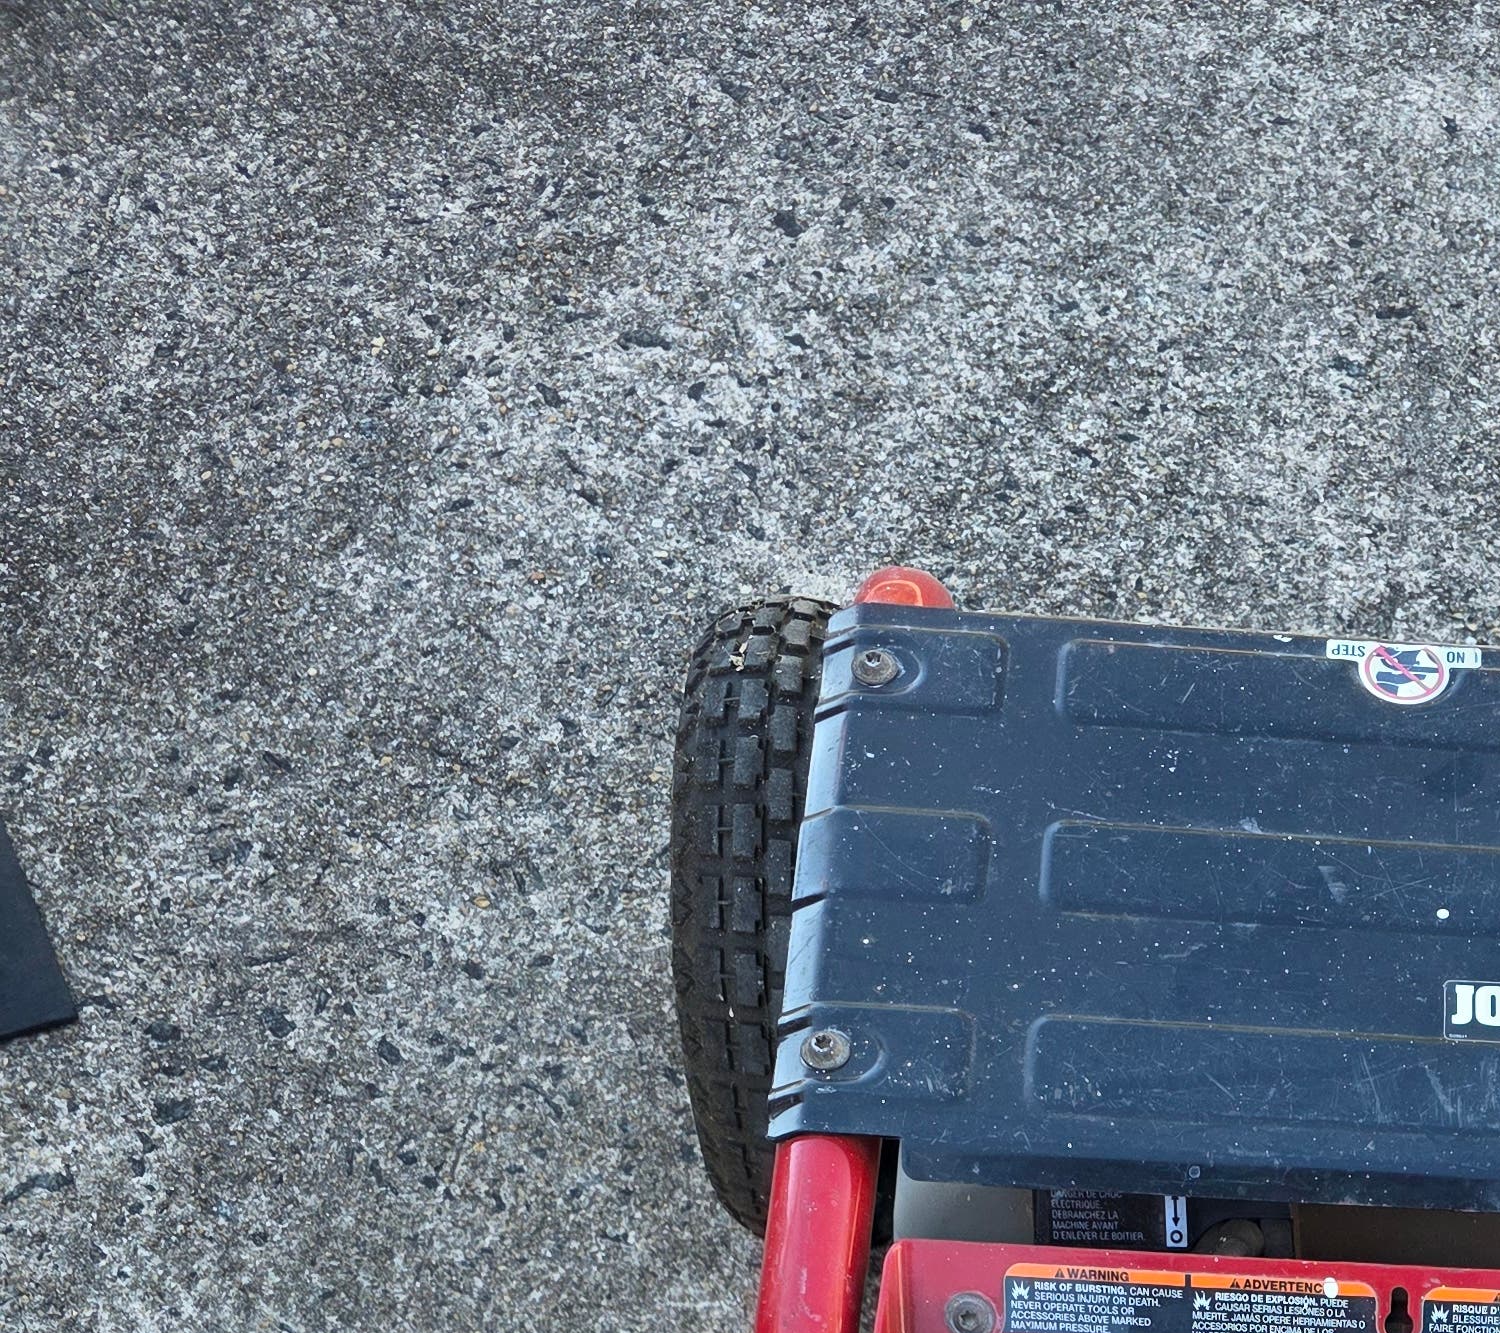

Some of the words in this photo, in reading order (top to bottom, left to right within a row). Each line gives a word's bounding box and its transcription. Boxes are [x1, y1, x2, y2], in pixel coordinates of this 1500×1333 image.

[1332, 644, 1365, 657] STEP
[1447, 652, 1464, 663] NO
[1108, 1211, 1118, 1219] LA
[1052, 1221, 1090, 1229] MACHINE
[1092, 1222, 1118, 1230] AVANT
[1067, 1268, 1129, 1281] WARNING
[1034, 1282, 1056, 1291] RISK
[1059, 1283, 1072, 1292] OF
[1076, 1284, 1127, 1295] BURSTING.
[1130, 1287, 1149, 1296] CAN
[1152, 1289, 1183, 1298] CAUSE
[1244, 1278, 1330, 1293] ADVERTENC
[1034, 1292, 1074, 1302] SERIOUS
[1077, 1294, 1110, 1304] INJURY
[1112, 1296, 1126, 1305] OR
[1215, 1292, 1249, 1302] RIESGO
[1251, 1294, 1263, 1303] DE
[1320, 1298, 1348, 1308] PUEDE
[1011, 1301, 1041, 1310] NEVER
[1043, 1302, 1085, 1312] OPERATE
[1088, 1305, 1118, 1314] TOOLS
[1120, 1306, 1134, 1315] OR
[1215, 1302, 1250, 1312] CAUSAR
[1252, 1305, 1282, 1314] SERIAS
[1335, 1309, 1346, 1317] LA
[1452, 1304, 1488, 1314] RISQUE
[1011, 1310, 1076, 1322] ACCESSORIES
[1078, 1314, 1109, 1324] ABOVE
[1112, 1316, 1151, 1326] MARKED
[1192, 1312, 1228, 1321] MUERTE.
[1262, 1316, 1290, 1324] OPERE
[1293, 1317, 1357, 1328] HERRAMIENTAS
[1359, 1321, 1366, 1329] O
[1011, 1320, 1057, 1330] MAXIMUM
[1060, 1323, 1111, 1333] PRESSURE.
[1192, 1321, 1246, 1332] ACCESORIOS
[1249, 1324, 1267, 1333] POR
[1429, 1324, 1454, 1332] FAIRE
